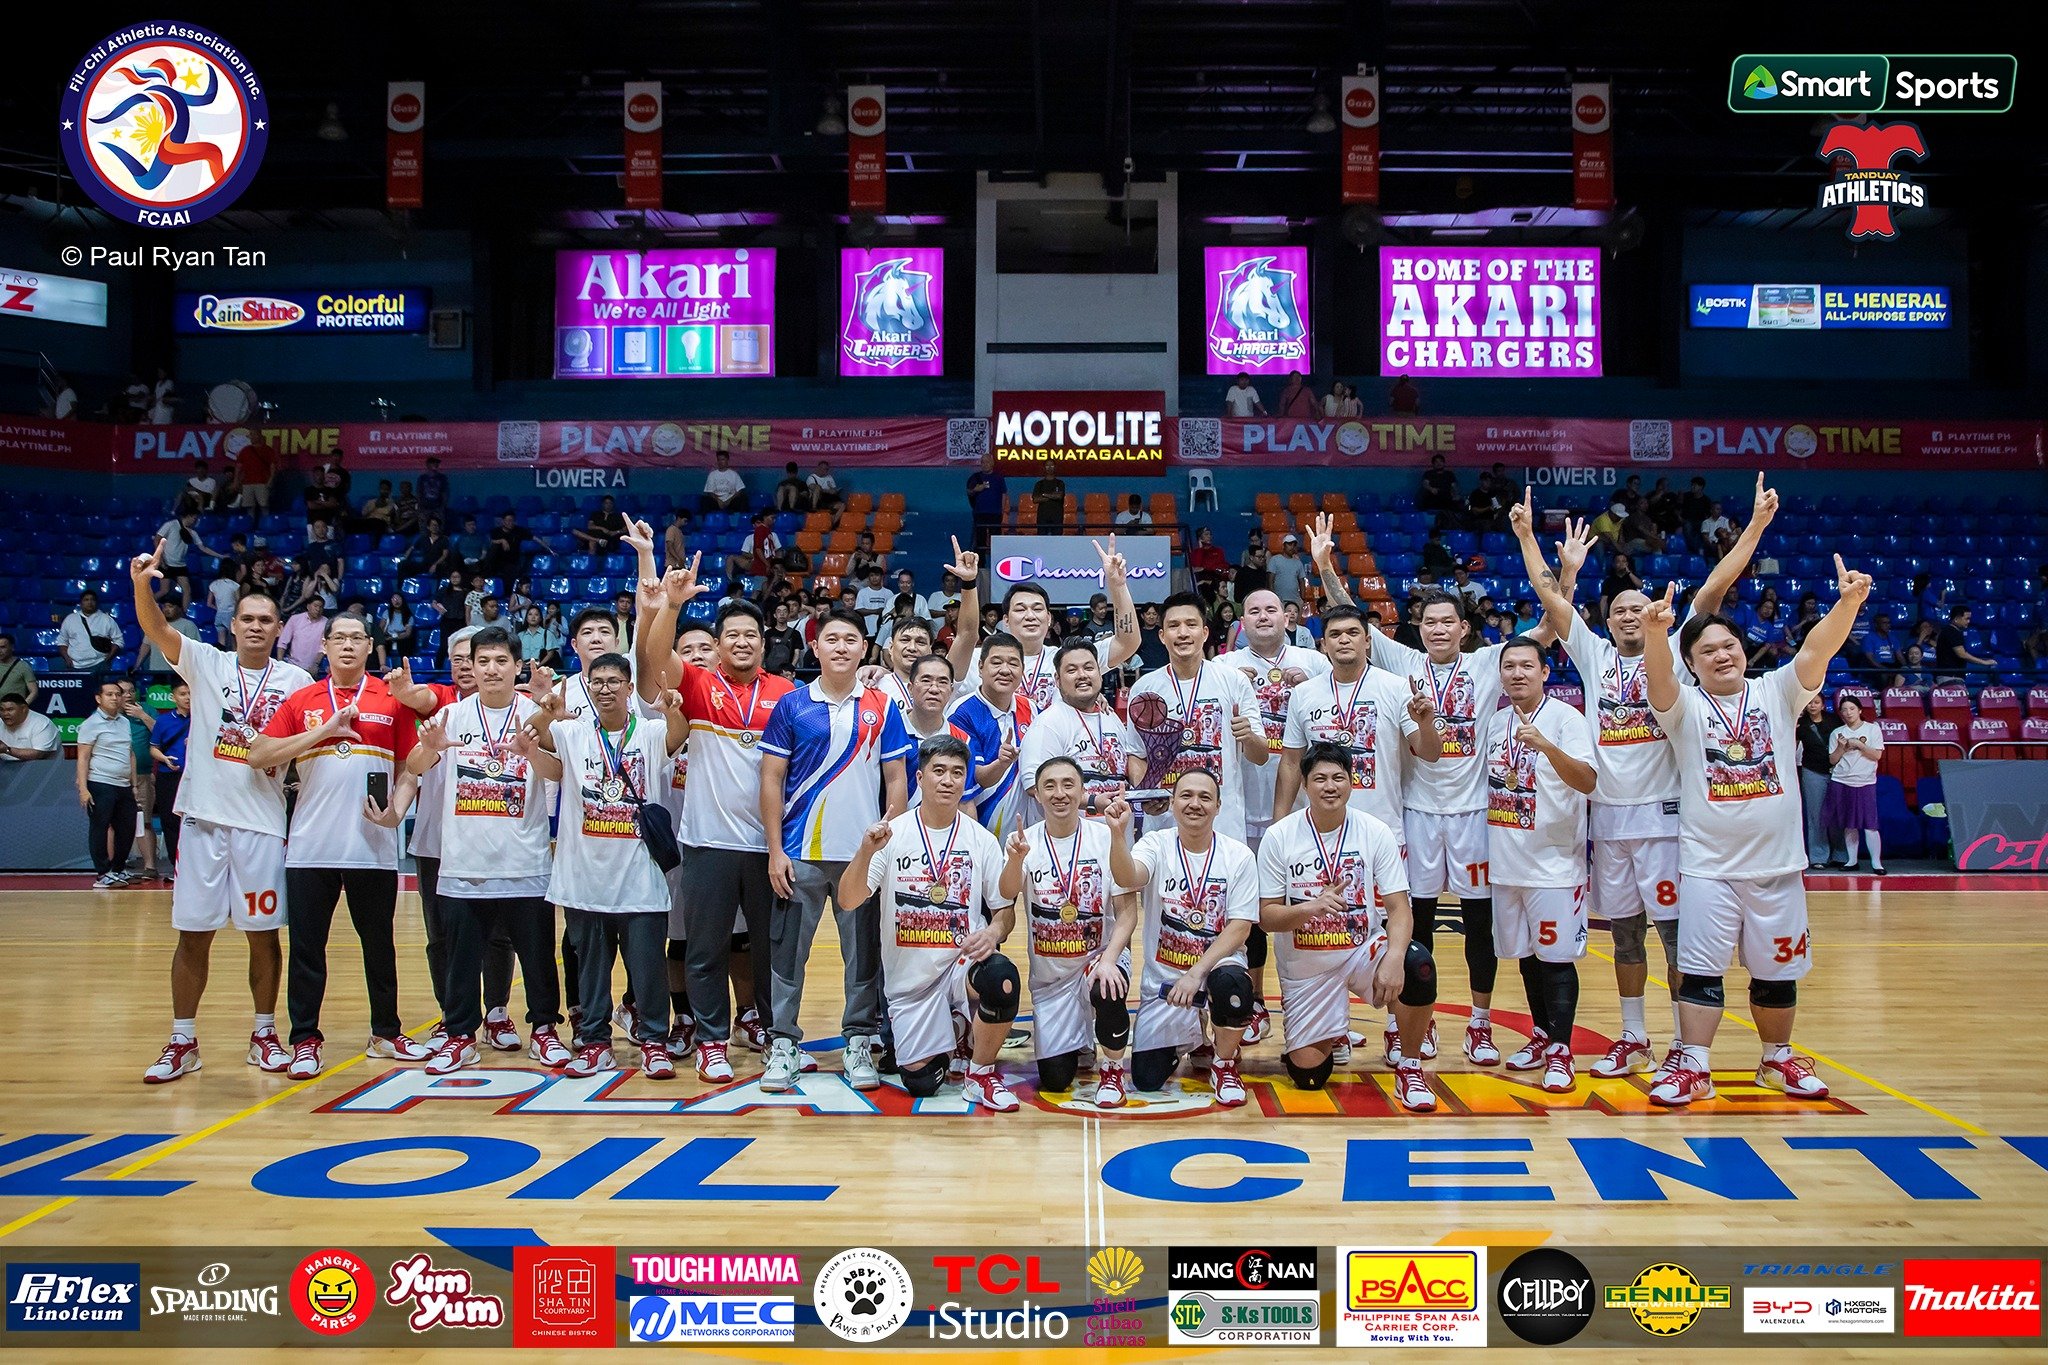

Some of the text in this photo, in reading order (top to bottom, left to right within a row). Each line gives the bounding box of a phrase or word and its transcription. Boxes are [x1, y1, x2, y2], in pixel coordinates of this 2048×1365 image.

[576, 248, 752, 301] Akari
[1392, 258, 1594, 282] HOME OF THE
[316, 294, 404, 314] Colorful
[1705, 297, 1746, 309] BOSTIK
[1825, 292, 1848, 309] EL
[1854, 293, 1947, 309] HENERAL
[316, 314, 404, 327] PROTECTION
[593, 302, 731, 322] We're All Light
[1386, 284, 1597, 338] AKARI
[1825, 311, 1947, 322] ALL-PURPOSE EPOXY
[871, 330, 911, 342] Akari
[1237, 329, 1278, 341] Akari
[1386, 340, 1594, 369] CHARGERS
[819, 429, 866, 438] PLAYTIME
[995, 410, 1162, 446] MOTOLITE
[1243, 424, 1456, 452] PLAY TIME
[134, 428, 341, 460] PLAY TIME
[560, 424, 772, 454] PLAY TIME
[791, 443, 889, 452] WWW.PLAYTIME.PH
[1476, 443, 1573, 452] WWW.PLAYTIME.PH
[1693, 427, 1901, 455] PLAY TIME
[997, 449, 1163, 461] PANGMATAGALAN
[535, 469, 626, 489] LOWER A
[1525, 467, 1616, 487] LOWER B
[36, 680, 82, 688] INGSIDE
[46, 693, 67, 714] A
[1601, 726, 1651, 741] CHAMPIONS
[1711, 780, 1767, 797] CHAMPIONS
[458, 799, 507, 812] CHAMPIONS
[585, 820, 635, 834] CHAMPIONS
[1466, 861, 1490, 887] 11
[1656, 879, 1678, 906] 8
[244, 889, 278, 917] 10
[899, 929, 953, 944] CHAMPIONS
[1296, 932, 1351, 946] CHAMPIONS
[1538, 920, 1558, 946] 5
[1037, 940, 1087, 954] CHAMPIONS
[1773, 932, 1807, 964] 34
[251, 1135, 840, 1200] OIL
